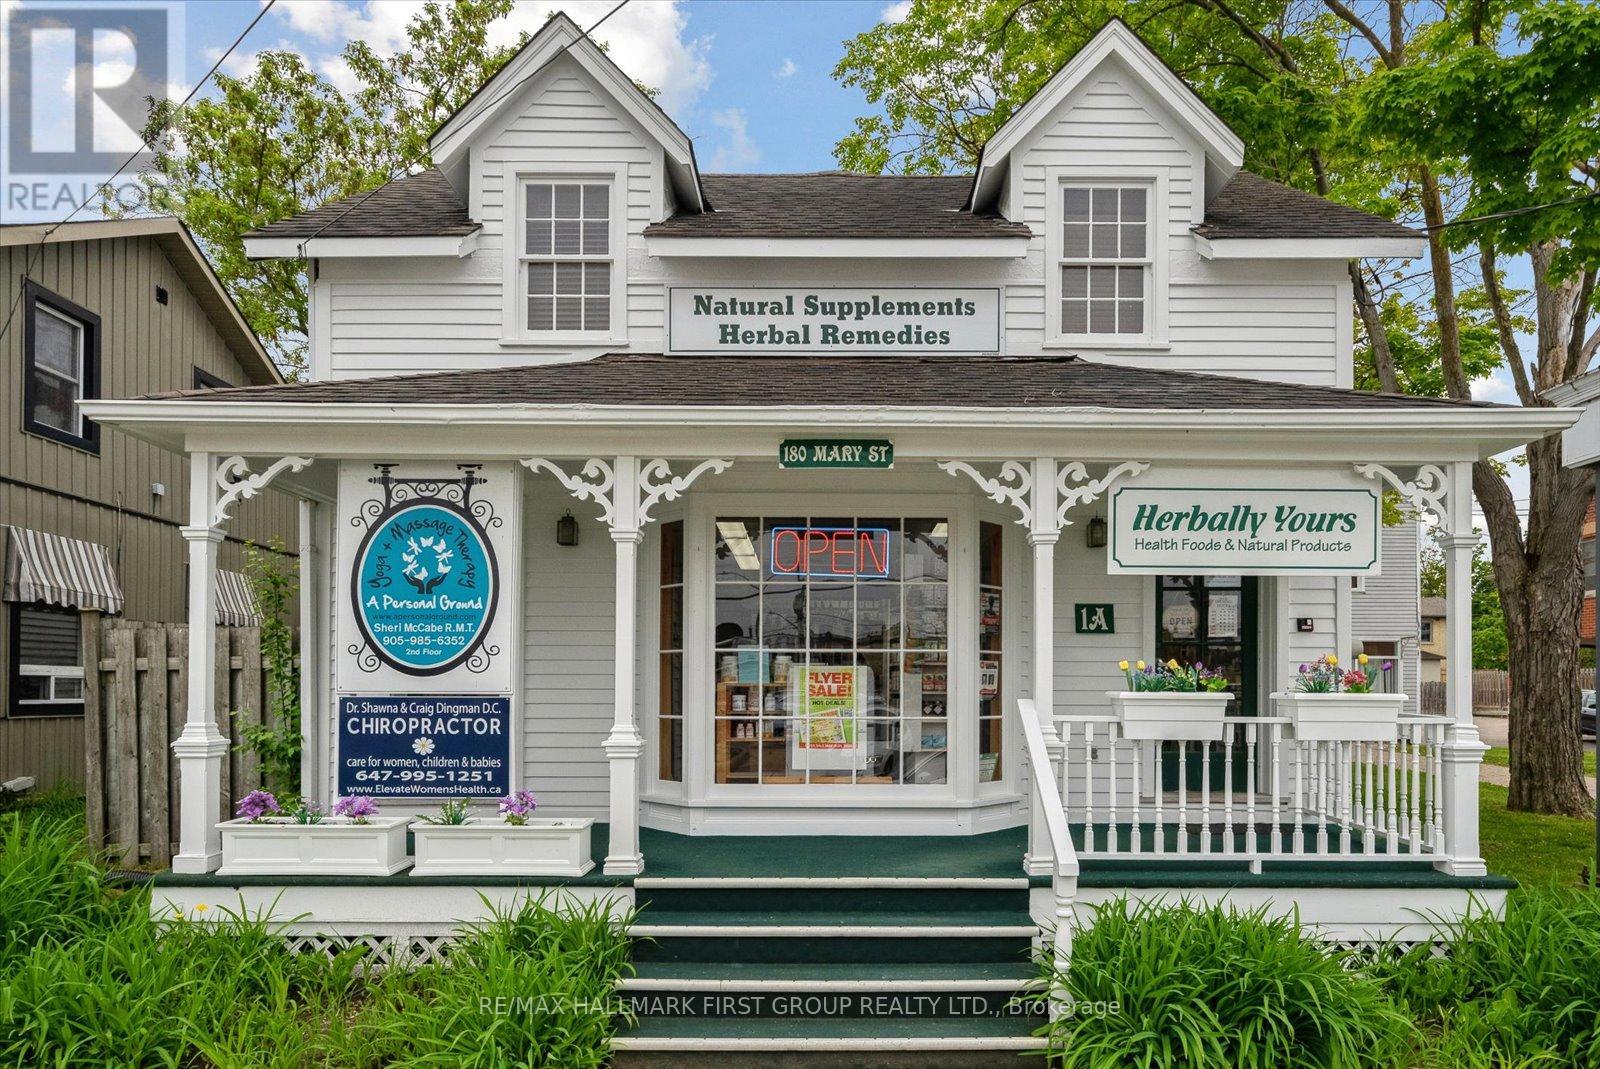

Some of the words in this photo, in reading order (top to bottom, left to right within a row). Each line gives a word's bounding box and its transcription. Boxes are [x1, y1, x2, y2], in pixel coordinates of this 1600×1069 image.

[694, 295, 794, 316] Natural
[804, 294, 976, 320] Supplements
[718, 324, 810, 345] Herbal
[820, 324, 950, 345] Remedies
[783, 446, 807, 462] 180
[813, 446, 862, 462] MARY
[868, 446, 890, 462] ST
[1132, 504, 1267, 539] Herbally
[1273, 505, 1357, 533] Yours
[775, 530, 886, 573] OPEN
[1135, 538, 1178, 551] Health
[1182, 538, 1222, 551] Foods
[1225, 539, 1235, 551] &
[1238, 538, 1288, 552] Natural
[1291, 539, 1352, 552] Products
[368, 555, 392, 588] Yoga
[390, 518, 454, 540] Massage
[453, 529, 476, 589] Therapy
[366, 595, 379, 610] A
[383, 594, 436, 610] Personal
[439, 594, 483, 610] Ground
[373, 613, 476, 621] www.apersonalground.com
[1080, 607, 1109, 631] 1A
[1169, 616, 1193, 625] OPEN
[374, 623, 401, 632] Sheri
[404, 623, 443, 632] McCabe
[445, 623, 475, 632] R.M.T.
[383, 636, 465, 645] 905-985-6352
[809, 685, 852, 697] SALE!
[346, 703, 360, 713] Dr.
[361, 702, 398, 713] Shawna
[400, 702, 408, 713] &
[409, 702, 434, 716] Craig
[436, 702, 480, 716] Dingman
[482, 703, 501, 714] D.C.
[347, 718, 501, 735] CHIROPRACTOR
[346, 758, 367, 767] care
[368, 756, 380, 767] for
[383, 758, 420, 768] women,
[421, 756, 460, 767] children
[461, 757, 469, 767] &
[470, 757, 501, 767] babies
[355, 771, 493, 781] 647-995-1251
[347, 785, 501, 794] www.ElevateWomensHealth.ca
